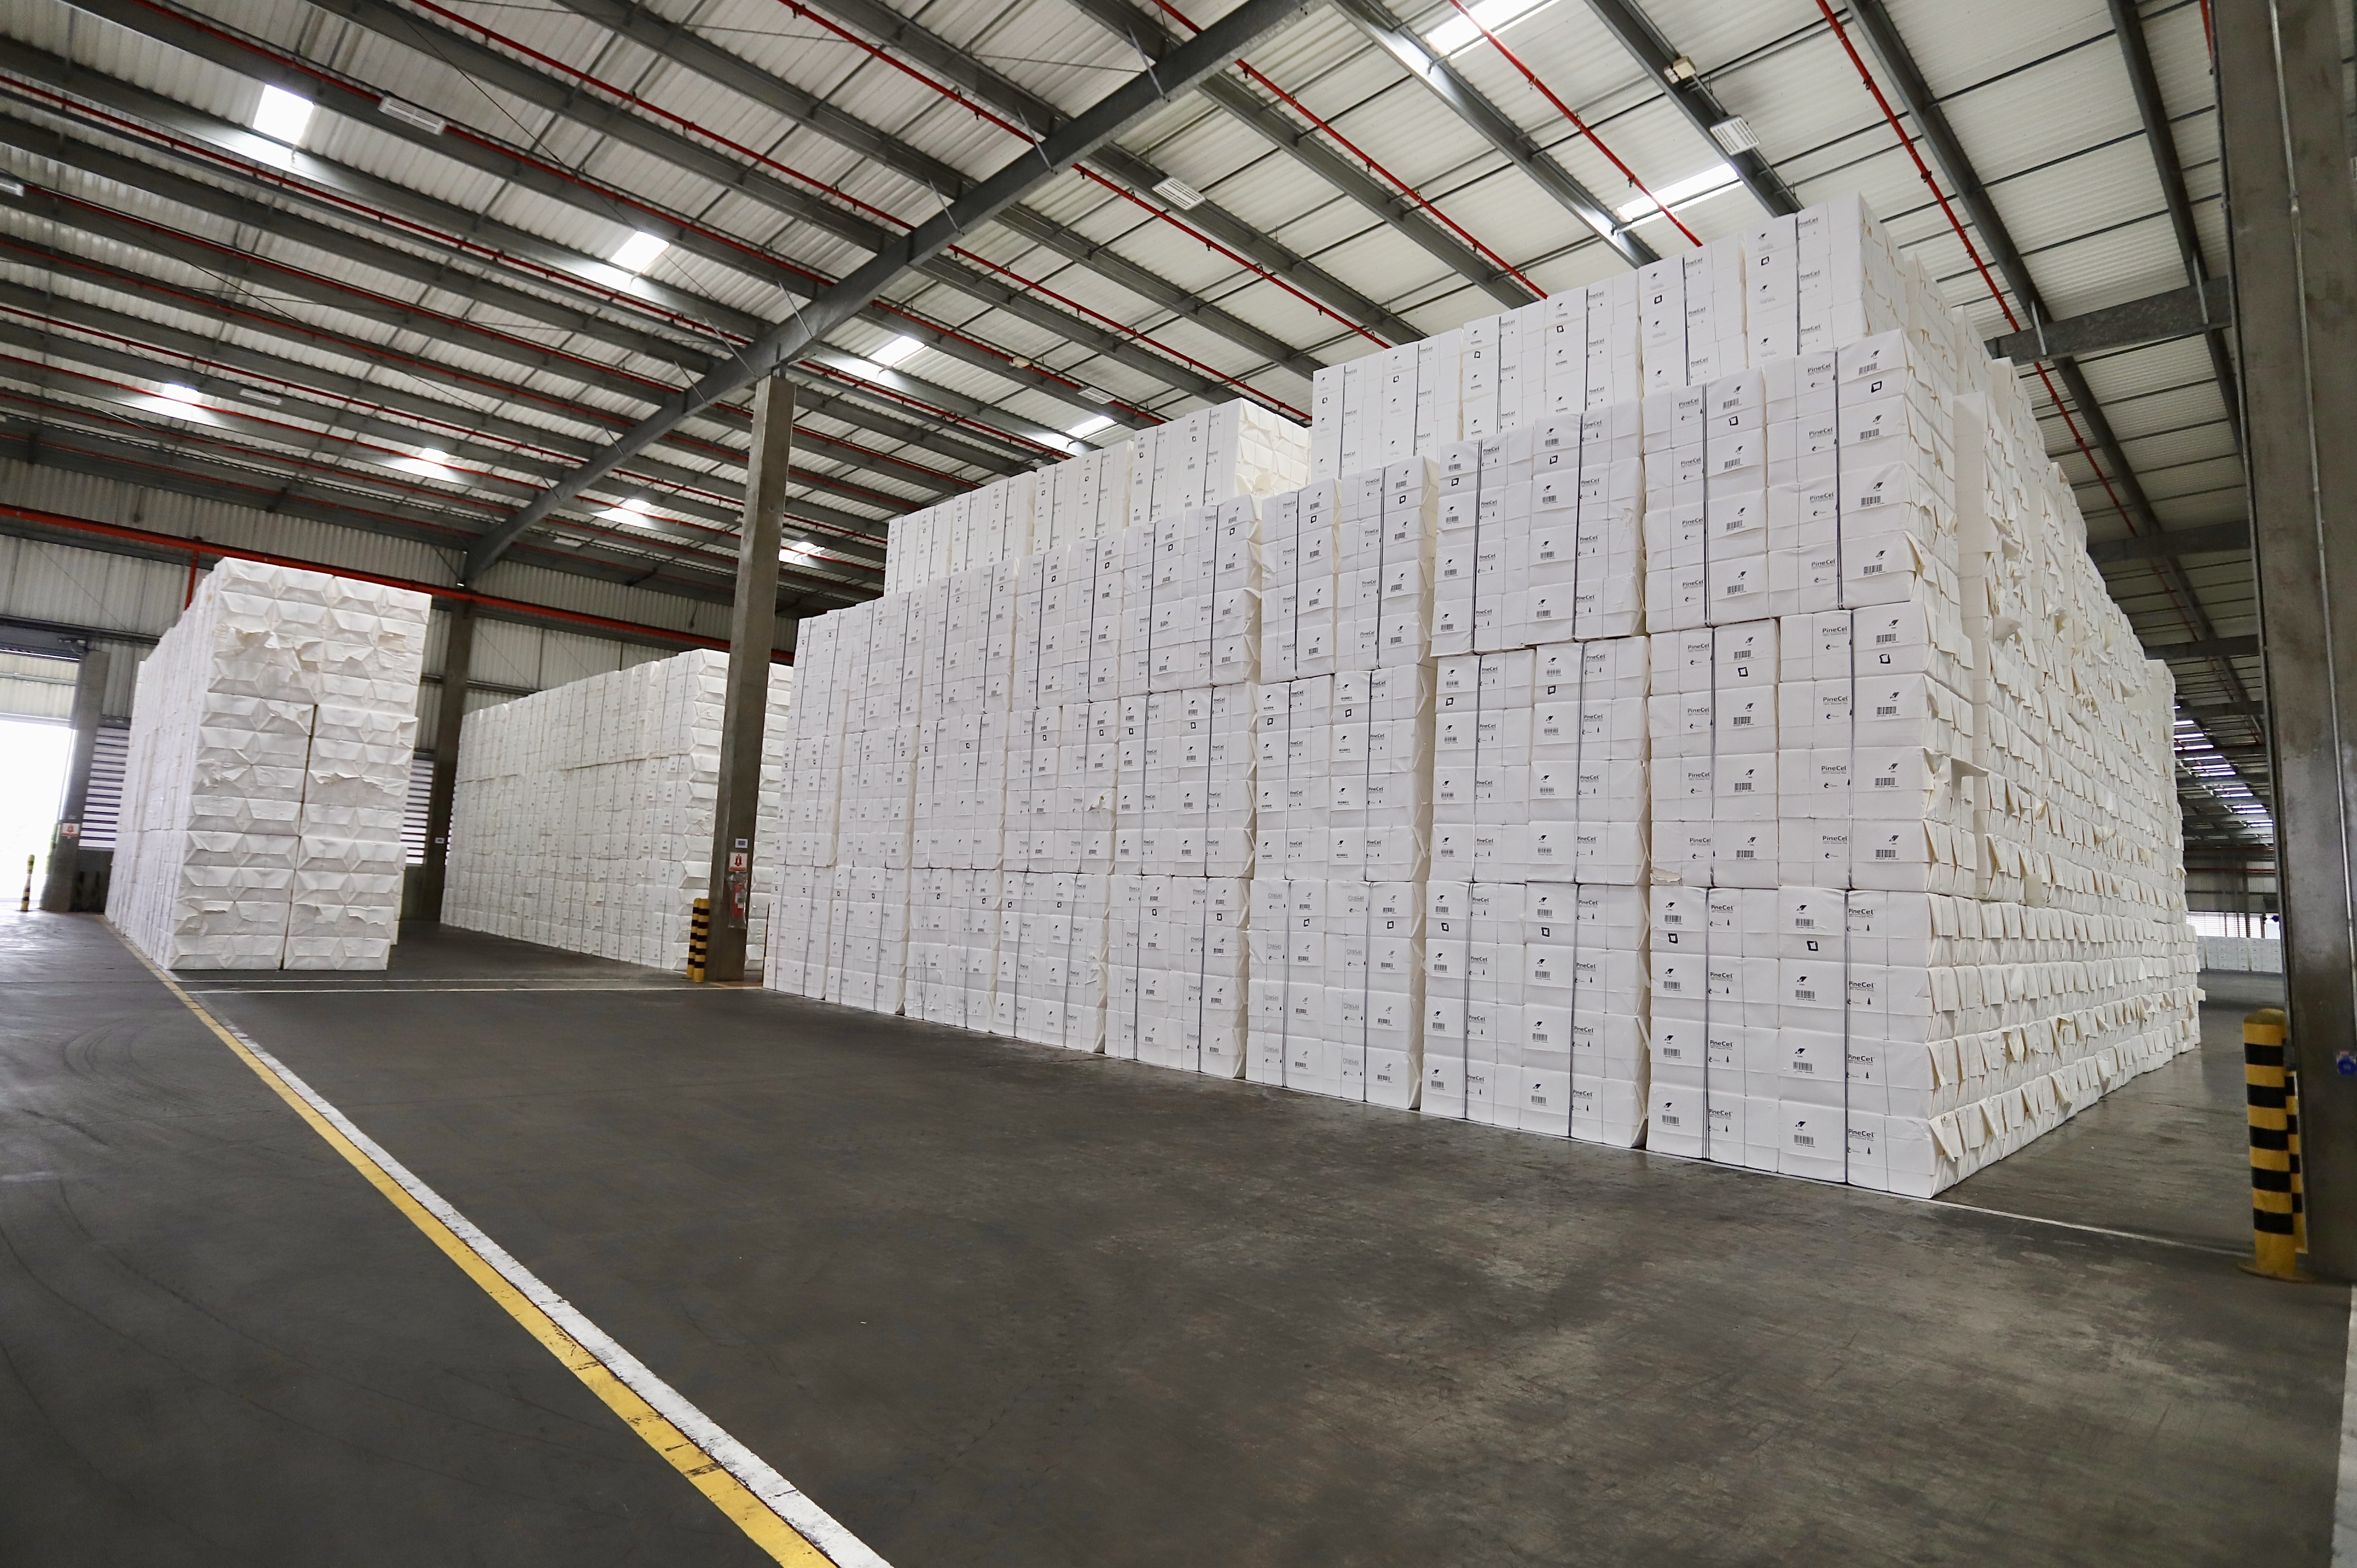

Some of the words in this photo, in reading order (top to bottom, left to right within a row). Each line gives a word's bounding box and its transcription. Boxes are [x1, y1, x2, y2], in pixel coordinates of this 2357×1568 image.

[1799, 217, 1818, 226] PineCel
[1685, 258, 1702, 266] PineCel
[1800, 270, 1819, 279] PineCel
[1801, 324, 1820, 333] PineCel
[1808, 364, 1831, 373] PineCel
[1848, 1129, 1874, 1137] PineCel
